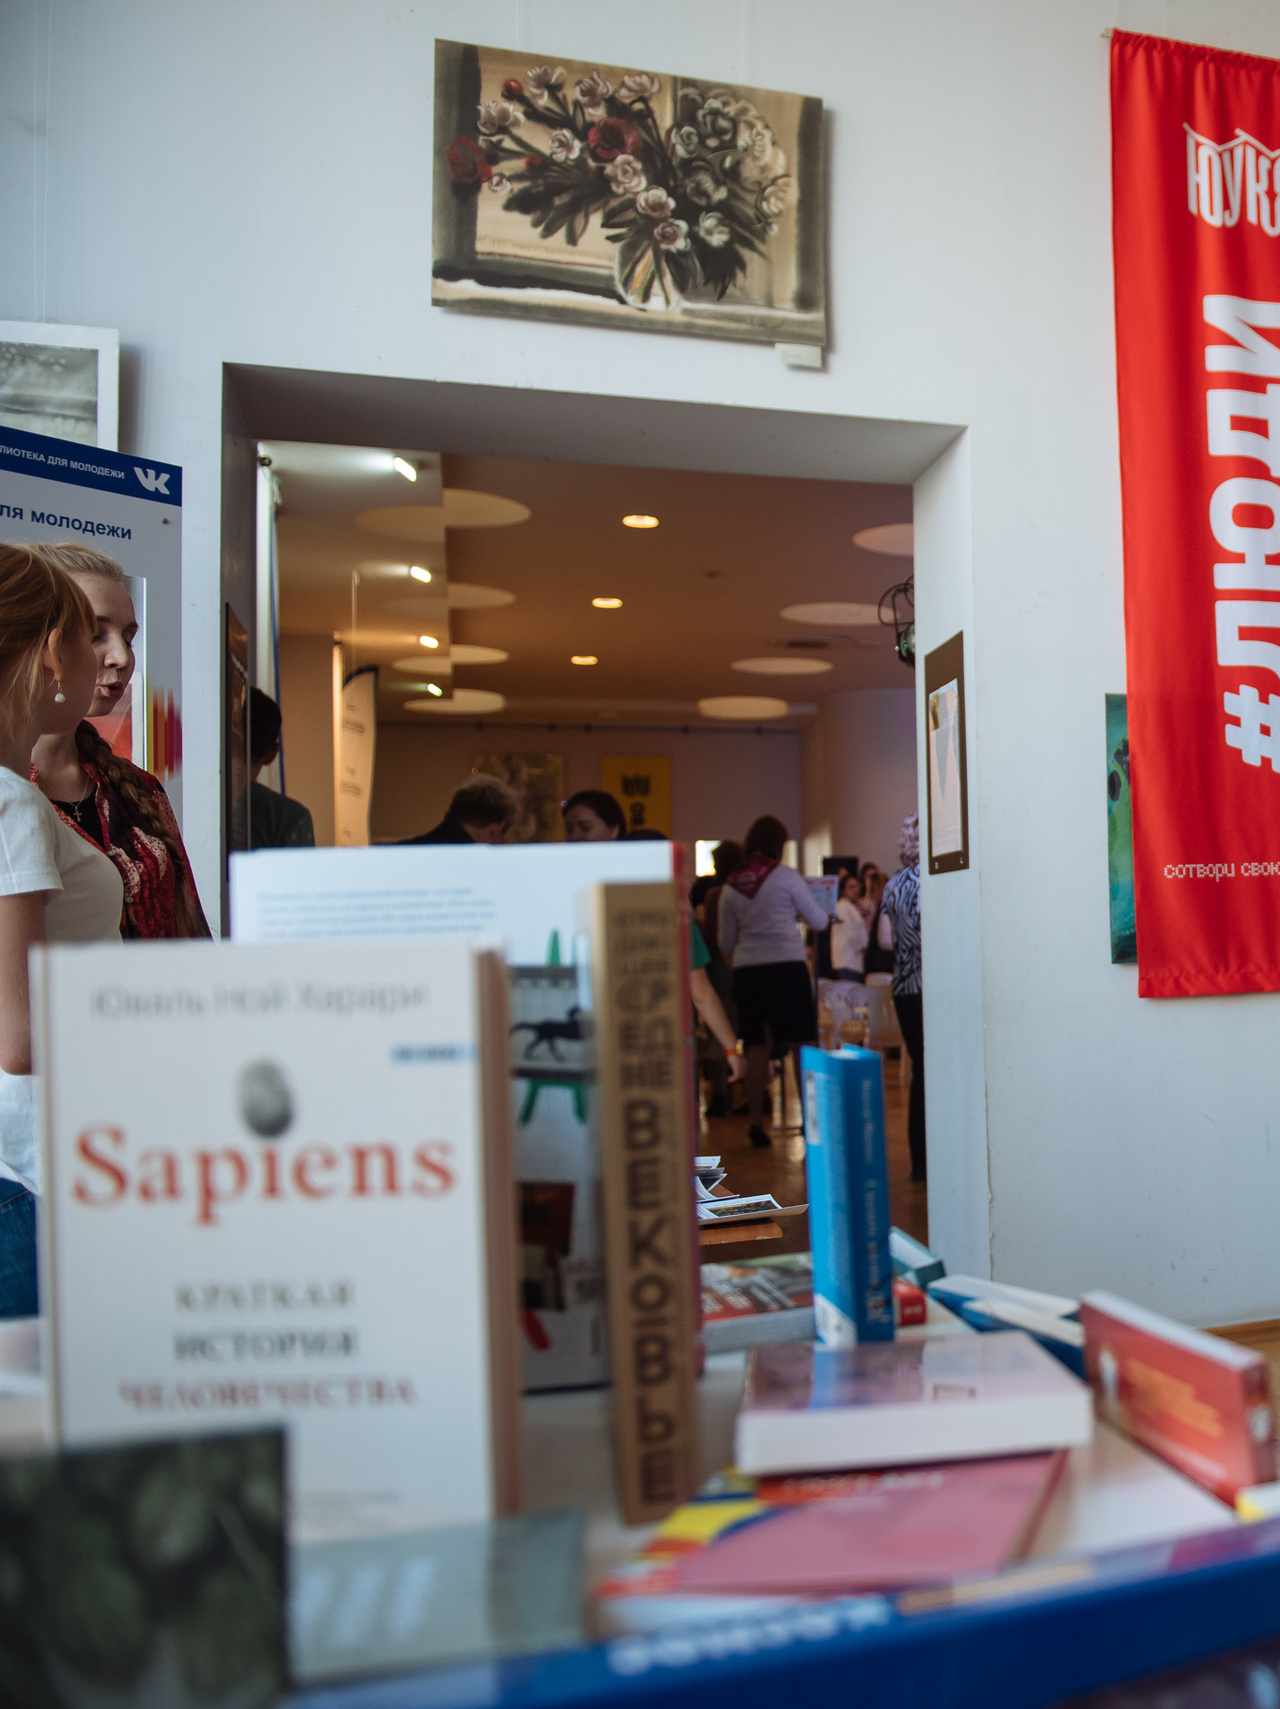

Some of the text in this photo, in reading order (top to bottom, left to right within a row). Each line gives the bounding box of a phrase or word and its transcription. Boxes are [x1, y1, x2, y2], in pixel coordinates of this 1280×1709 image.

[0, 445, 125, 480] ЛИОТЕКА ДЛЯ МОЛОДЕЖИ
[133, 466, 170, 495] VK
[0, 504, 132, 540] ля молодежи
[1164, 863, 1236, 883] сотвори
[73, 1124, 457, 1226] Sapiens
